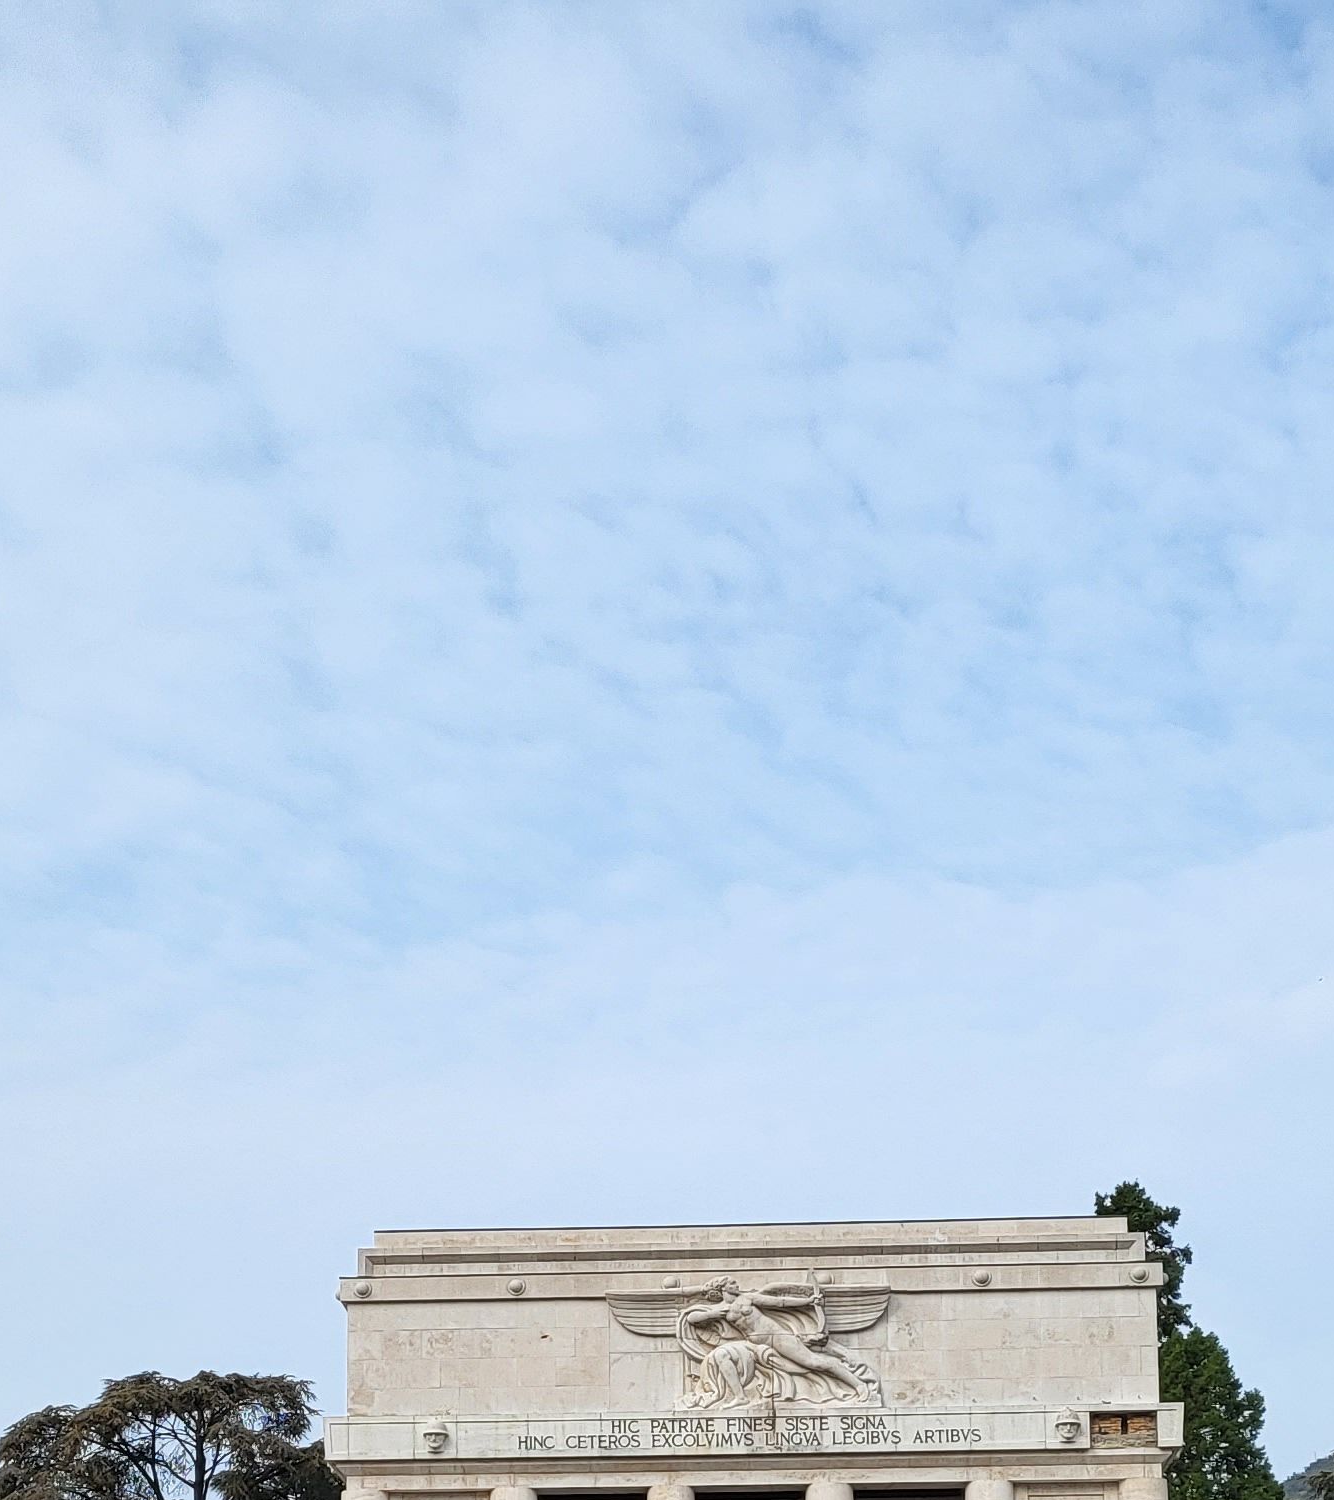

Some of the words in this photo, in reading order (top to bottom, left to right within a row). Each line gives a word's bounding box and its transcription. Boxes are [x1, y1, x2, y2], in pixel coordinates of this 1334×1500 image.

[611, 1420, 641, 1434] HIC
[650, 1418, 716, 1433] PATRIAE
[726, 1417, 775, 1433] FINES
[785, 1416, 830, 1431] SISTE
[839, 1415, 887, 1431] SIGNA
[517, 1435, 556, 1450] HINC
[565, 1434, 641, 1449] CETEROS
[651, 1432, 755, 1448] EXCOLVIMVS
[765, 1431, 822, 1446] LINGVA
[832, 1430, 902, 1445] LEGIBVS
[912, 1428, 982, 1444] ARTIBVS
